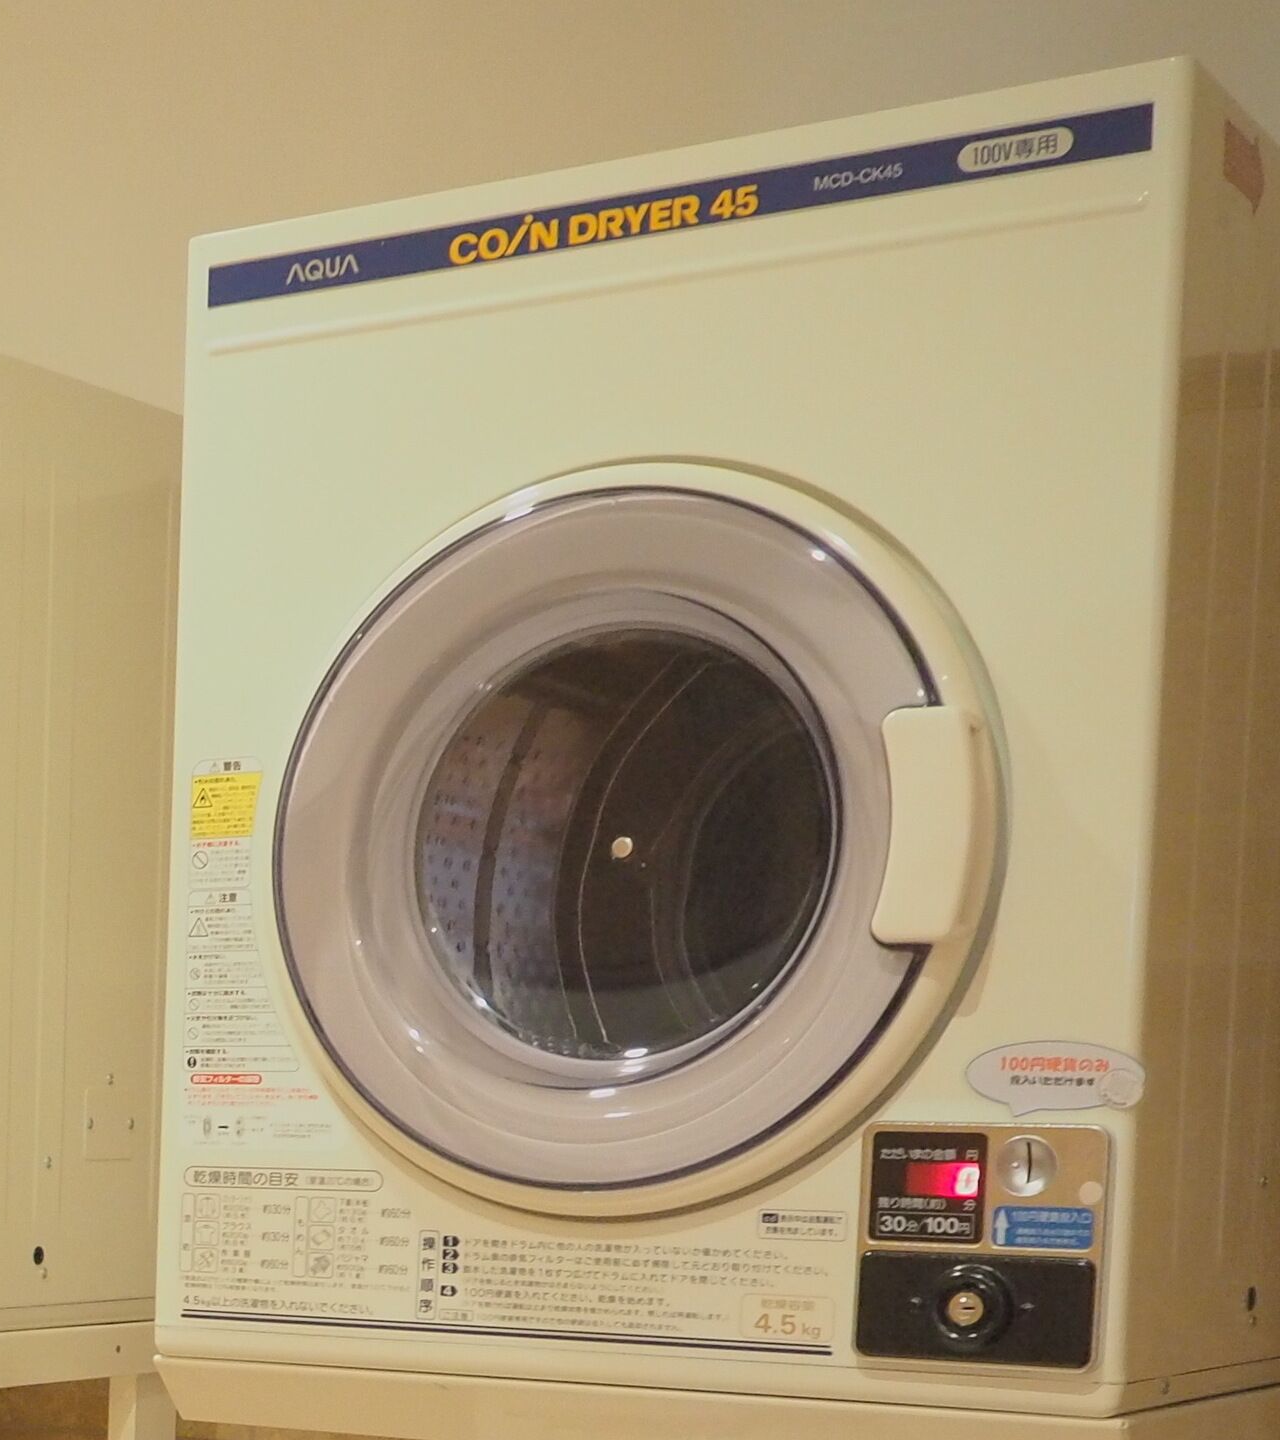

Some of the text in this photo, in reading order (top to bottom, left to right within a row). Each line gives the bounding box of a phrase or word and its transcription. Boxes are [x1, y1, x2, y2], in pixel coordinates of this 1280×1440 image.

[970, 133, 1061, 167] 100V専用
[285, 252, 360, 286] AQUA
[568, 195, 700, 245] DRYER
[711, 185, 760, 222] 45
[813, 162, 905, 192] MCD-CK45
[219, 893, 237, 903] 注意
[1000, 1056, 1110, 1073] 100円硬貨のみ
[1010, 1076, 1096, 1087] 投入いただけます
[965, 1149, 980, 1160] 円
[193, 1170, 298, 1187] 乾燥時間の目安
[963, 1200, 977, 1212] 分
[879, 1215, 972, 1235] 30分/100円
[420, 1237, 436, 1313] 操作順序
[754, 1313, 822, 1340] 4.5 kg
